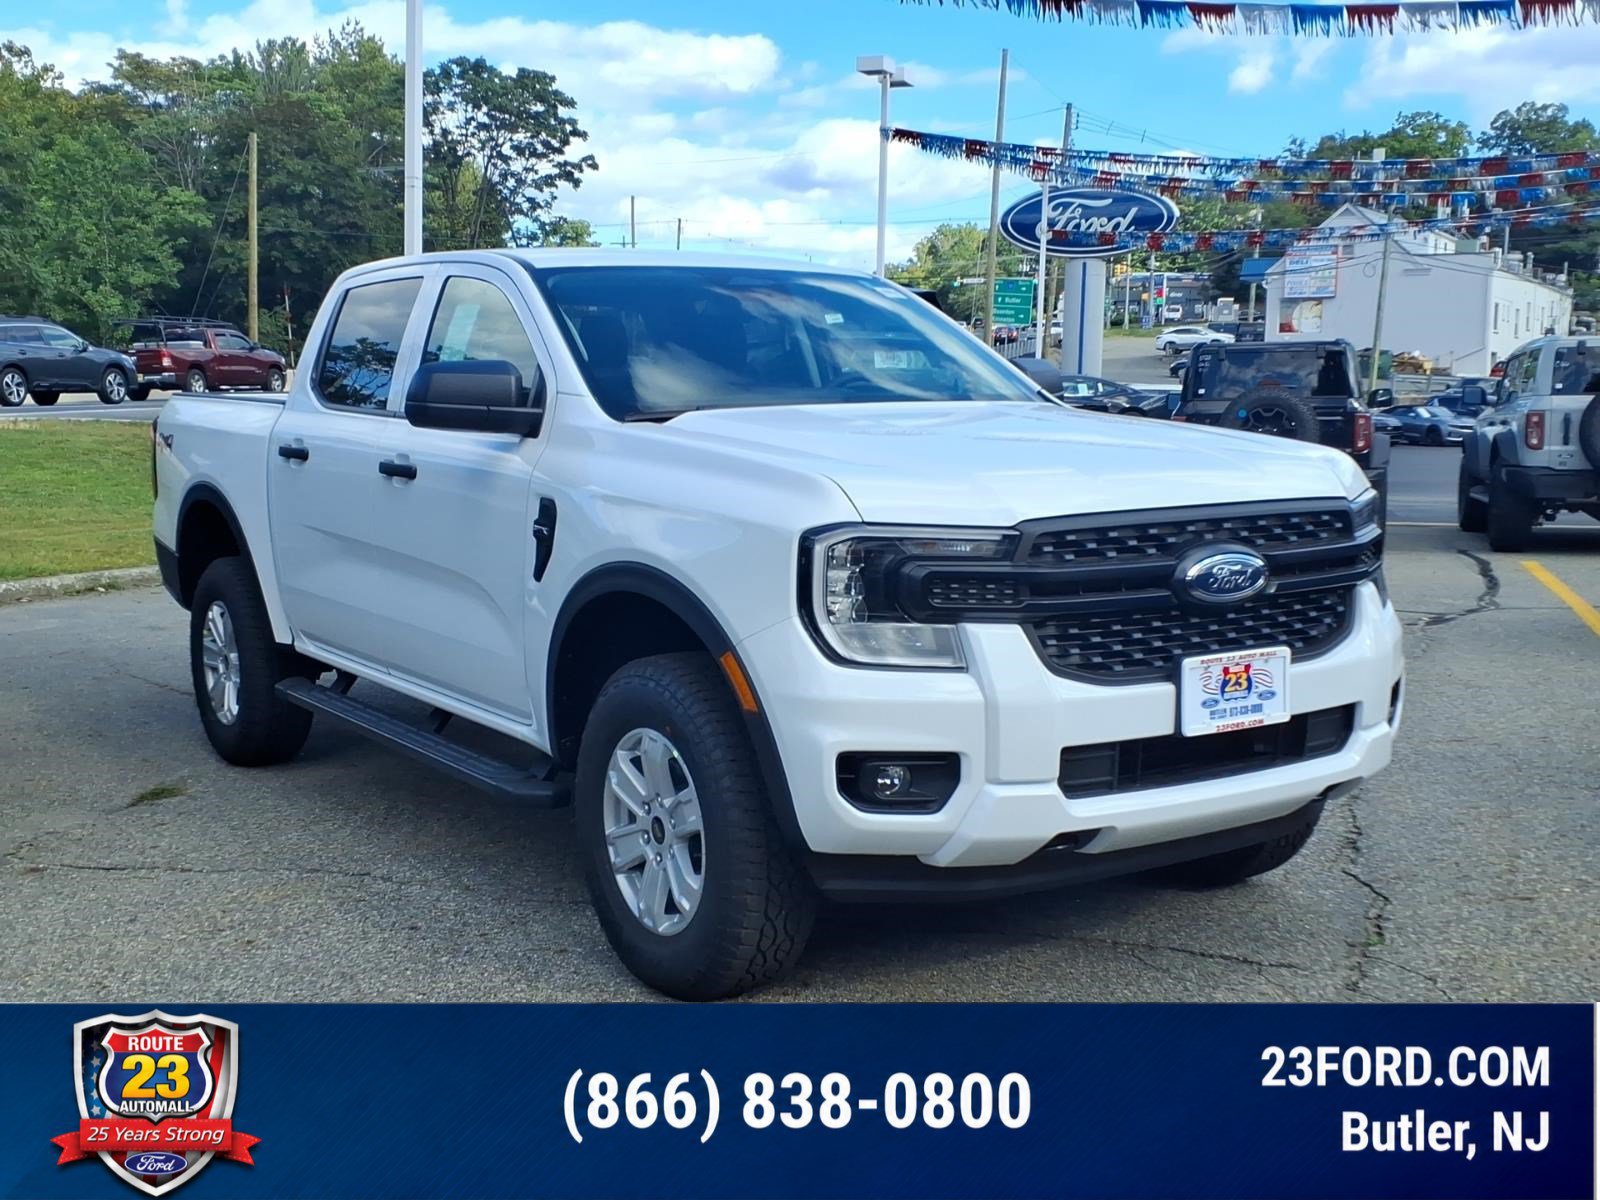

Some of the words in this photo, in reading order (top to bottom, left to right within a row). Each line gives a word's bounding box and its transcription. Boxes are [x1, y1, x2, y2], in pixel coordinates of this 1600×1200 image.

[1035, 198, 1135, 241] Ford
[1208, 564, 1253, 591] Ford
[1224, 671, 1248, 692] 23
[1216, 719, 1264, 732] 23FORD.COM
